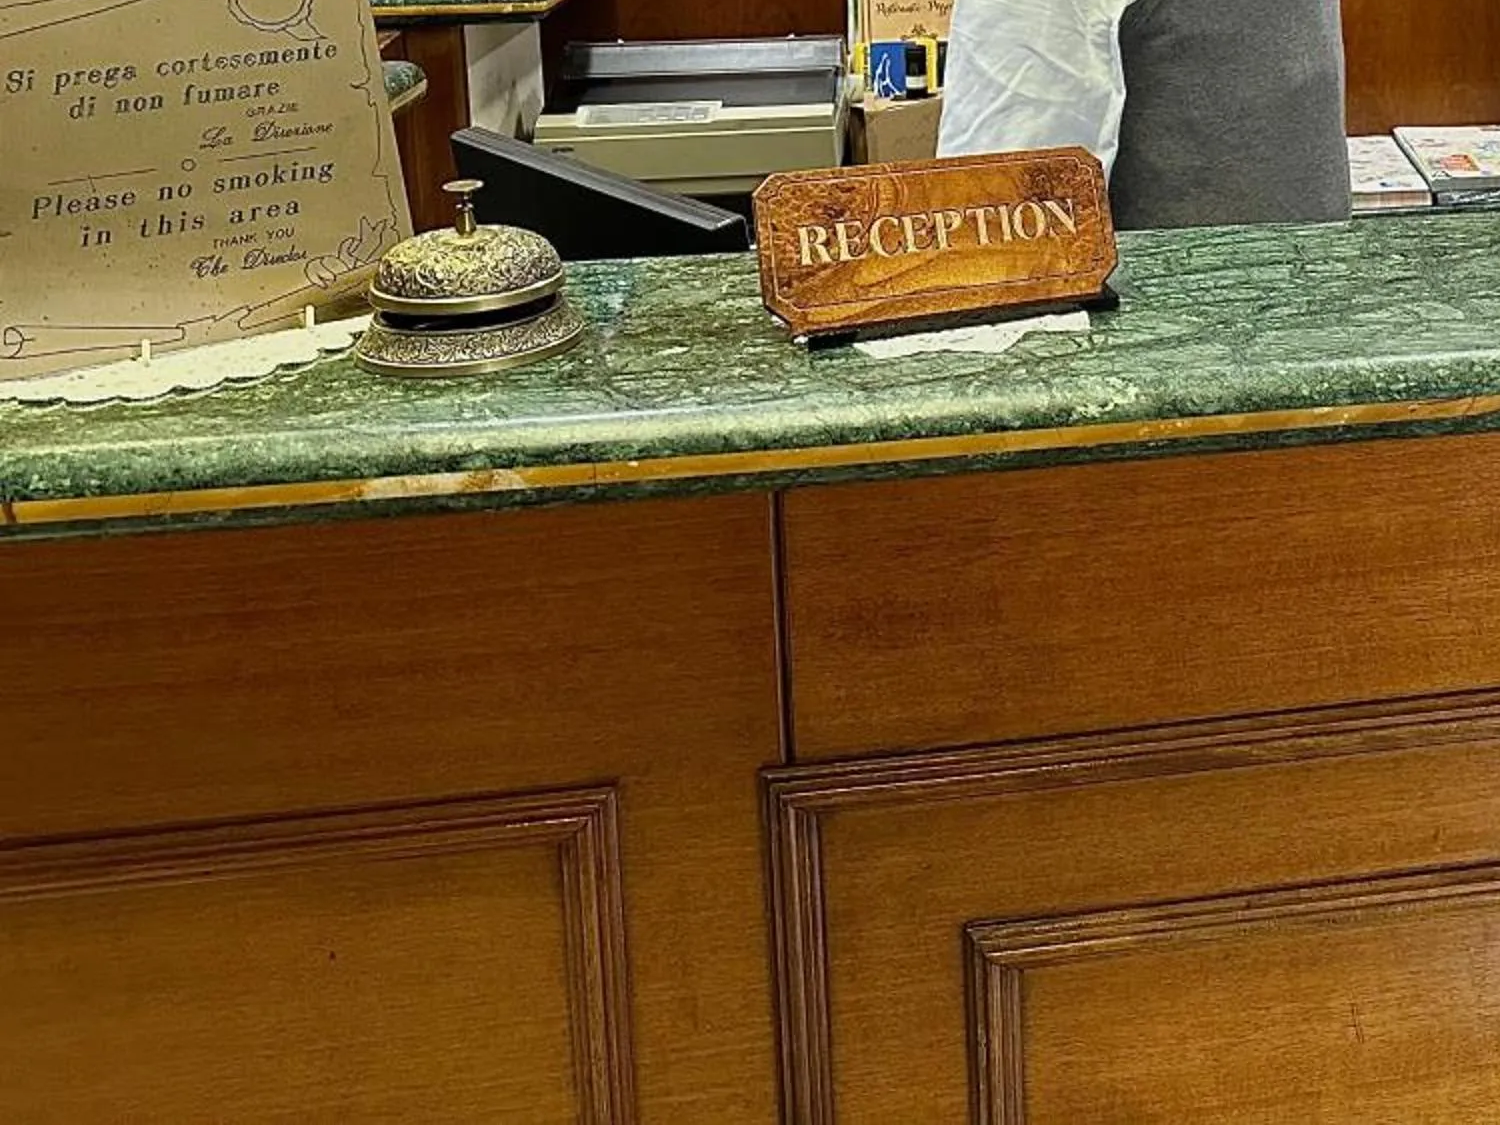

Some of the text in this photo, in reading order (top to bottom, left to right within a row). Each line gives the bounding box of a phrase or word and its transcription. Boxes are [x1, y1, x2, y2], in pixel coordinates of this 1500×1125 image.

[4, 40, 339, 97] Si prega cortesemente
[68, 78, 281, 121] di non fumare
[243, 101, 300, 119] GRAZIE
[198, 119, 335, 151] La Direzione
[30, 157, 336, 221] Please no smoking
[79, 198, 301, 249] in this area
[212, 225, 296, 251] THANK YOU
[798, 197, 1080, 267] RECEPTION
[189, 252, 230, 279] The
